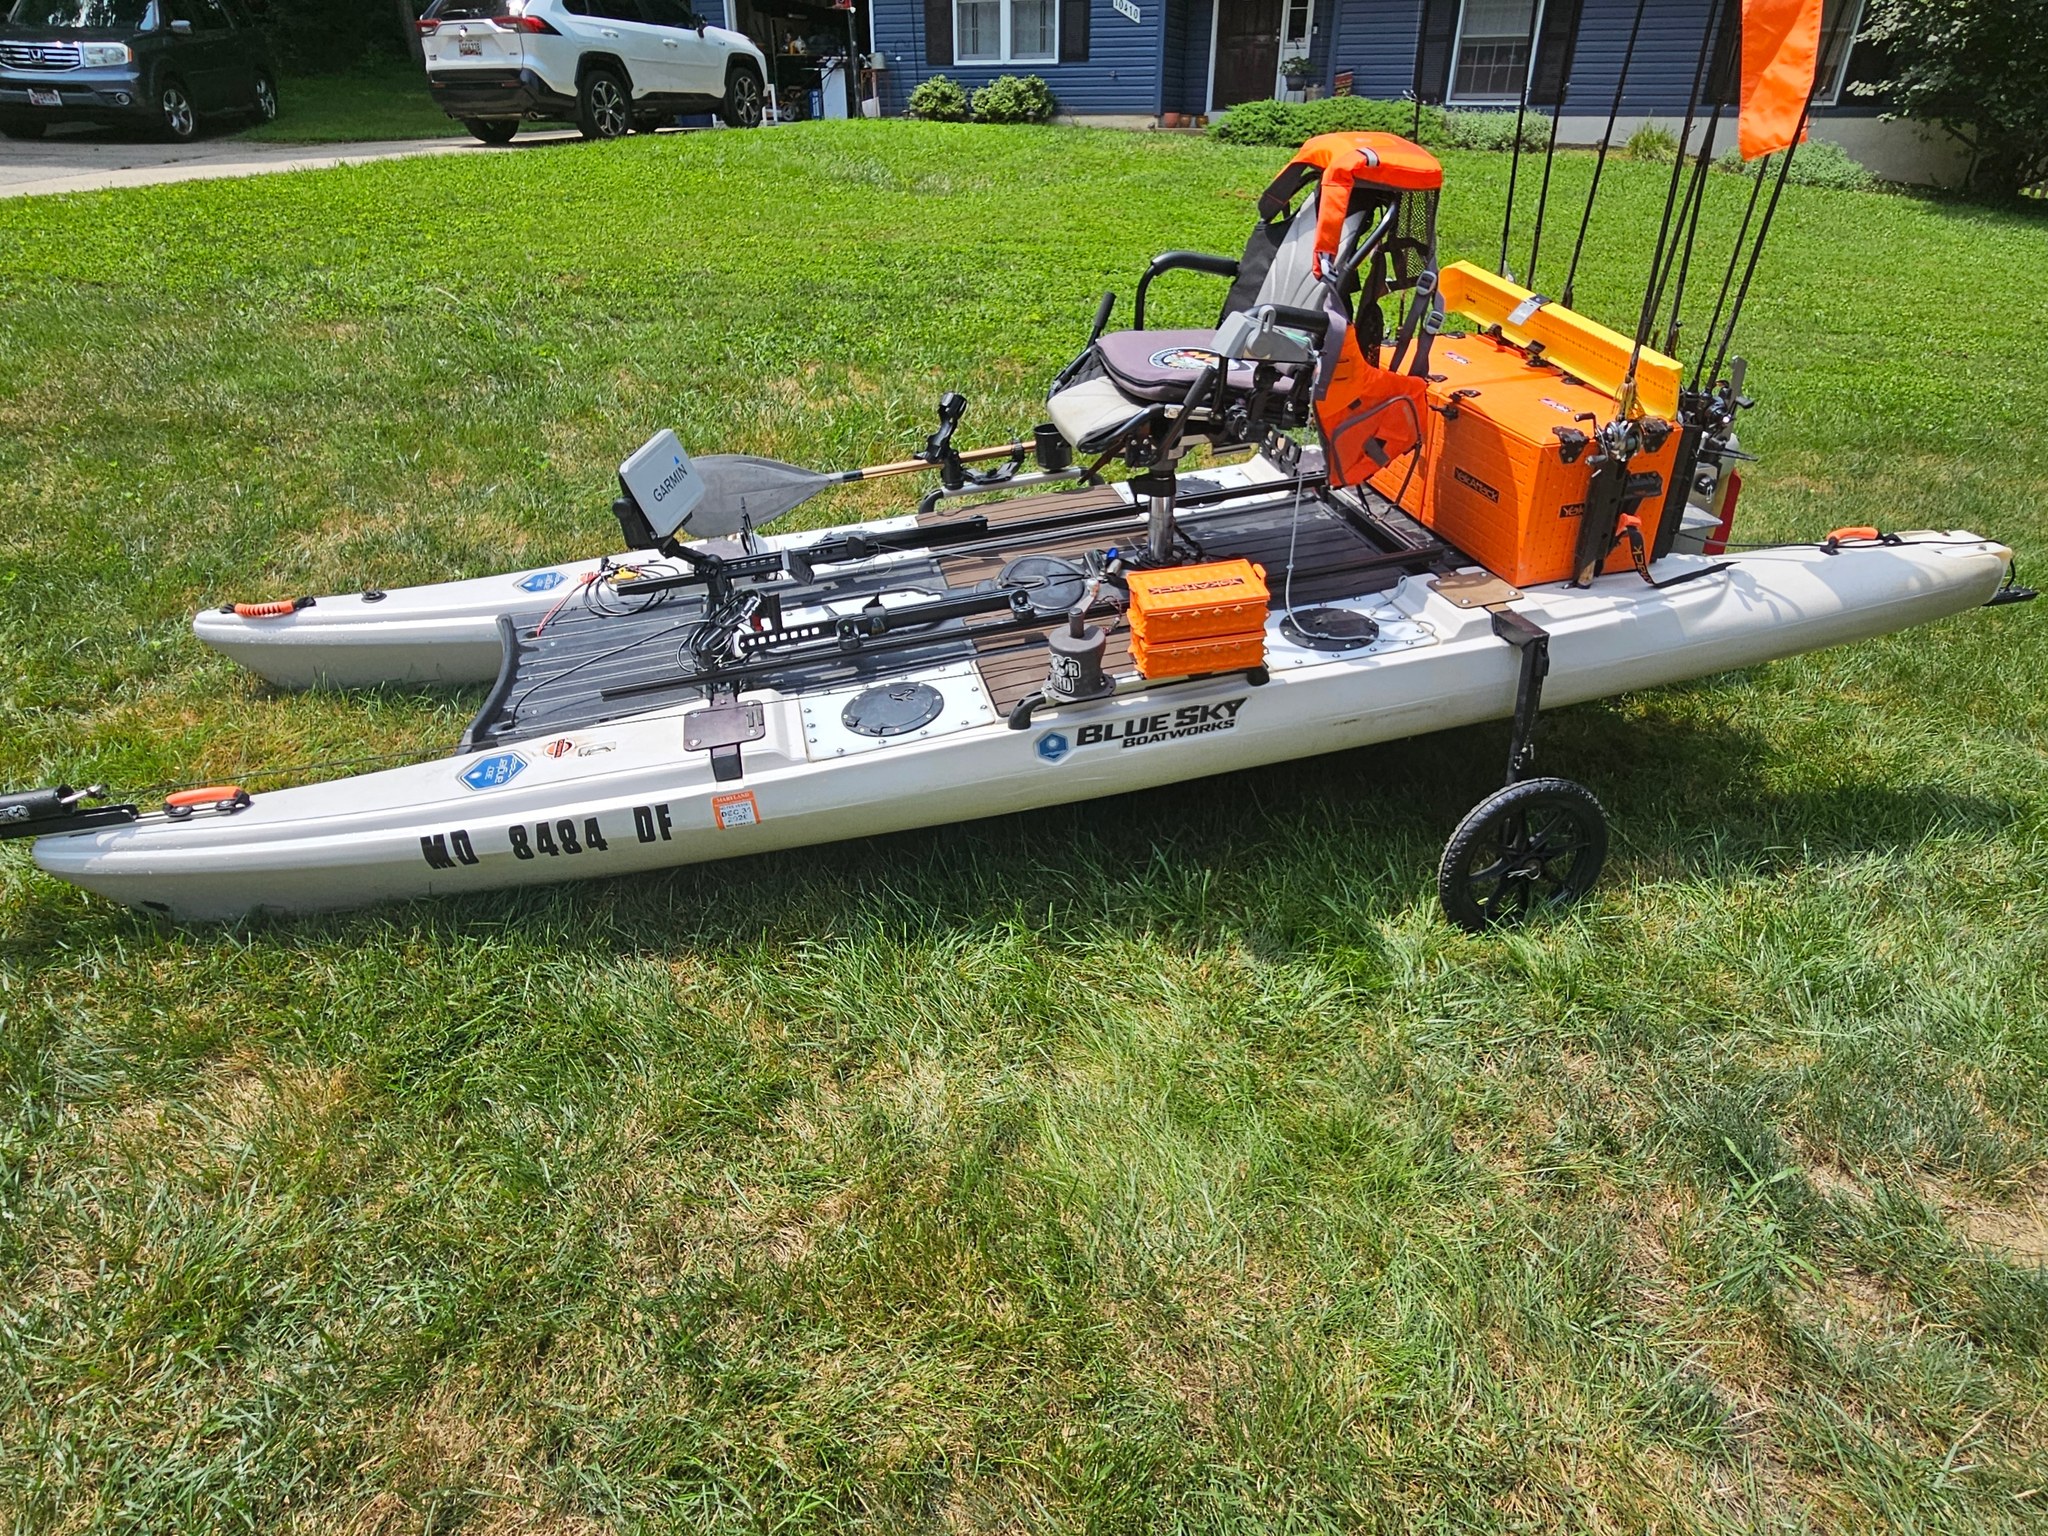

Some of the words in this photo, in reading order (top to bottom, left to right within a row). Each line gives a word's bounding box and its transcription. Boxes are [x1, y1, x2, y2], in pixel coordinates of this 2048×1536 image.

[653, 463, 688, 502] GARMIN
[1076, 713, 1170, 746] BLUE
[1174, 697, 1248, 727] SKY
[1122, 719, 1235, 748] BOATWORKS
[508, 817, 608, 860] 8484
[633, 804, 672, 843] DF
[721, 809, 740, 818] DEC
